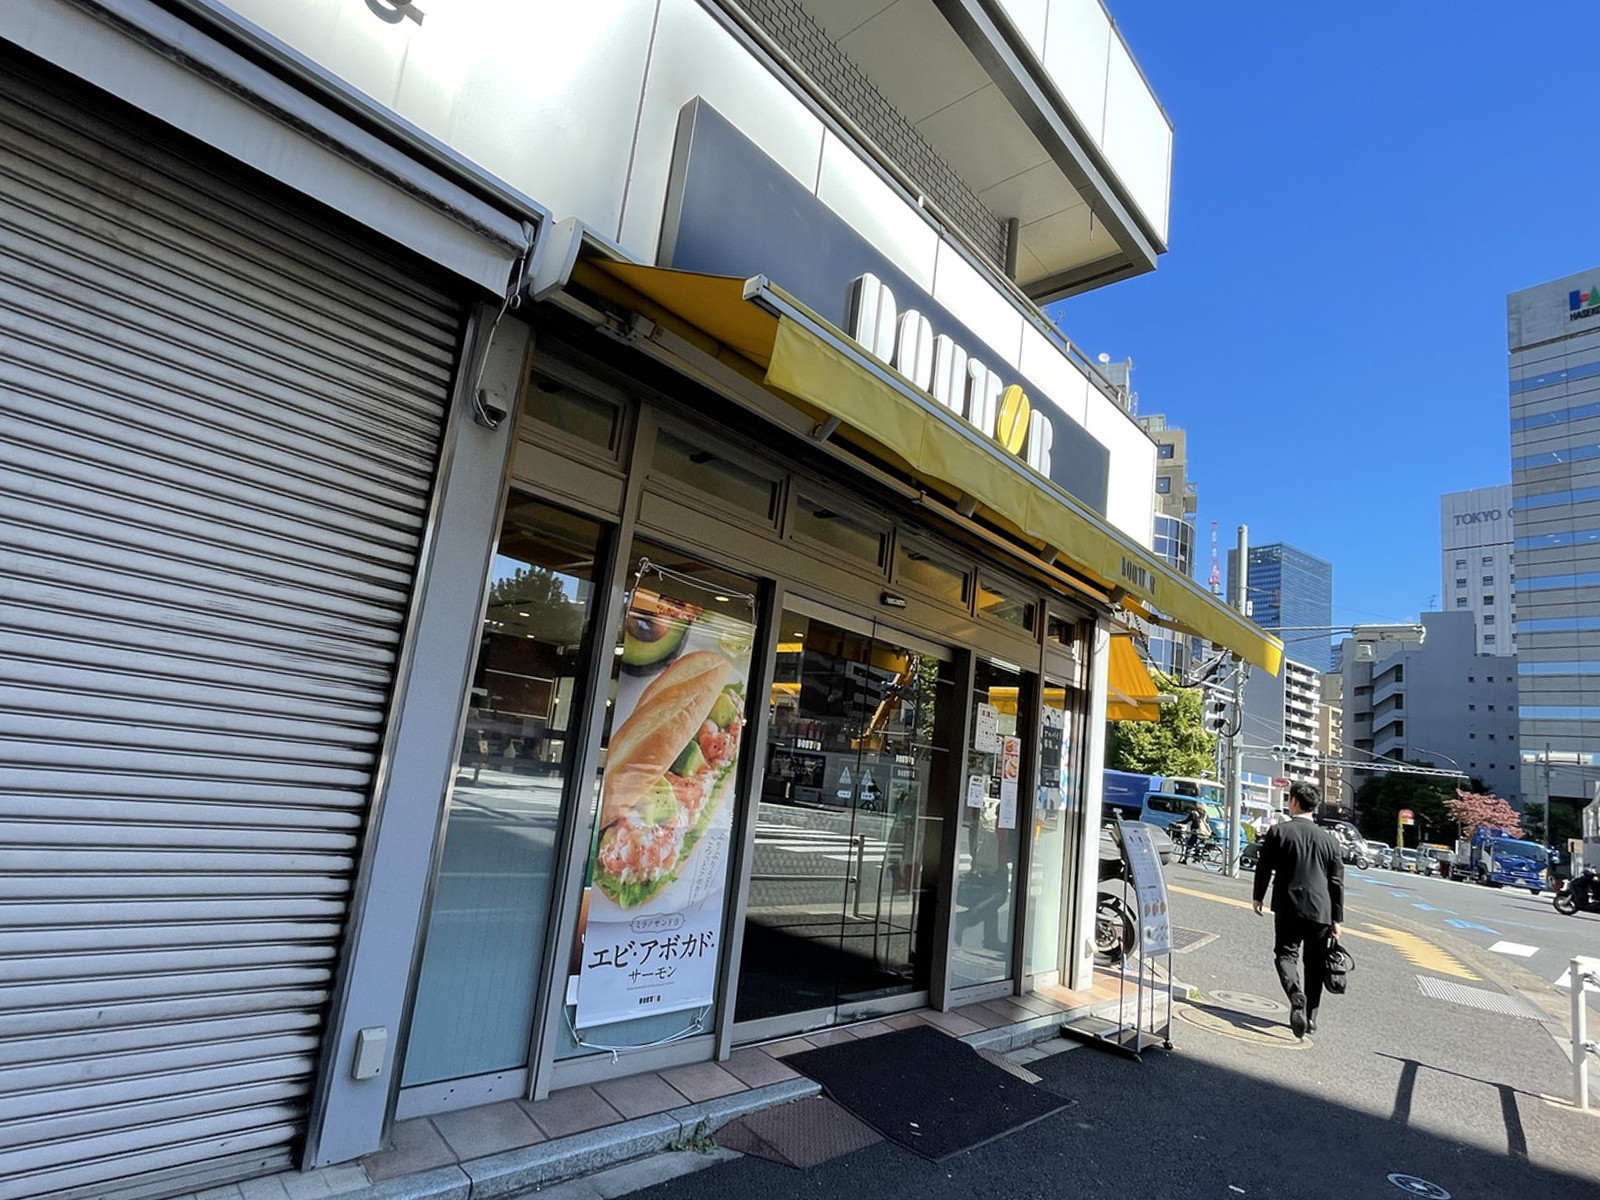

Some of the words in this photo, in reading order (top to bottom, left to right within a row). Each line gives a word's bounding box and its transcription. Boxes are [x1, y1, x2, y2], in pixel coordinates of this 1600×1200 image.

[851, 272, 1053, 480] DOUTOR
[1453, 509, 1502, 526] TOKYO
[628, 965, 678, 984] サーモン
